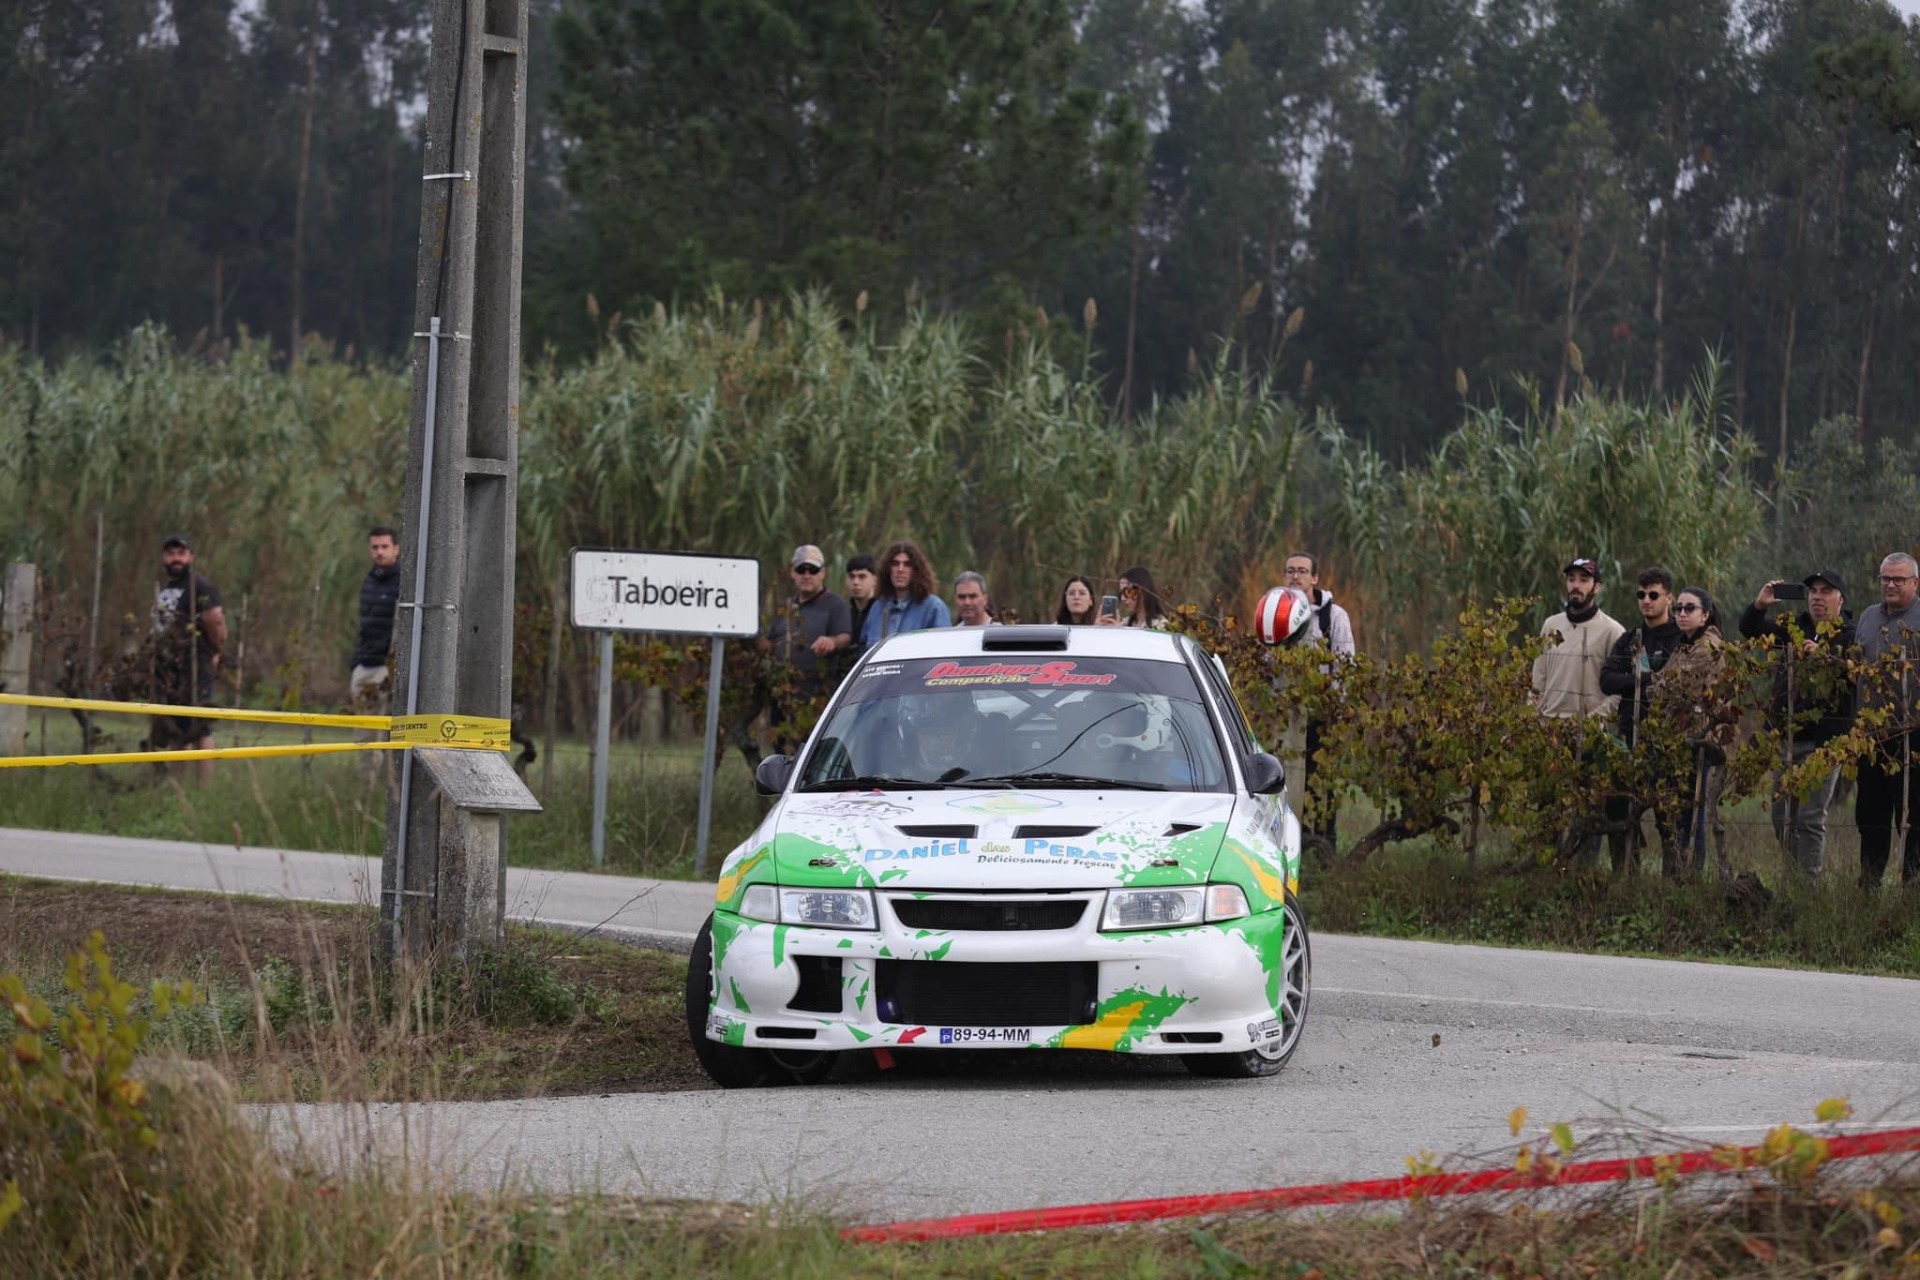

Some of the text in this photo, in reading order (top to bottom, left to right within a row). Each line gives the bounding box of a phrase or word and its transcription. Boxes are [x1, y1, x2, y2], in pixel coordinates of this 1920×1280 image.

[607, 575, 729, 609] Taboeira
[981, 842, 1011, 853] das
[1024, 839, 1118, 861] PERAS
[953, 1028, 1031, 1041] 89-94-MM
